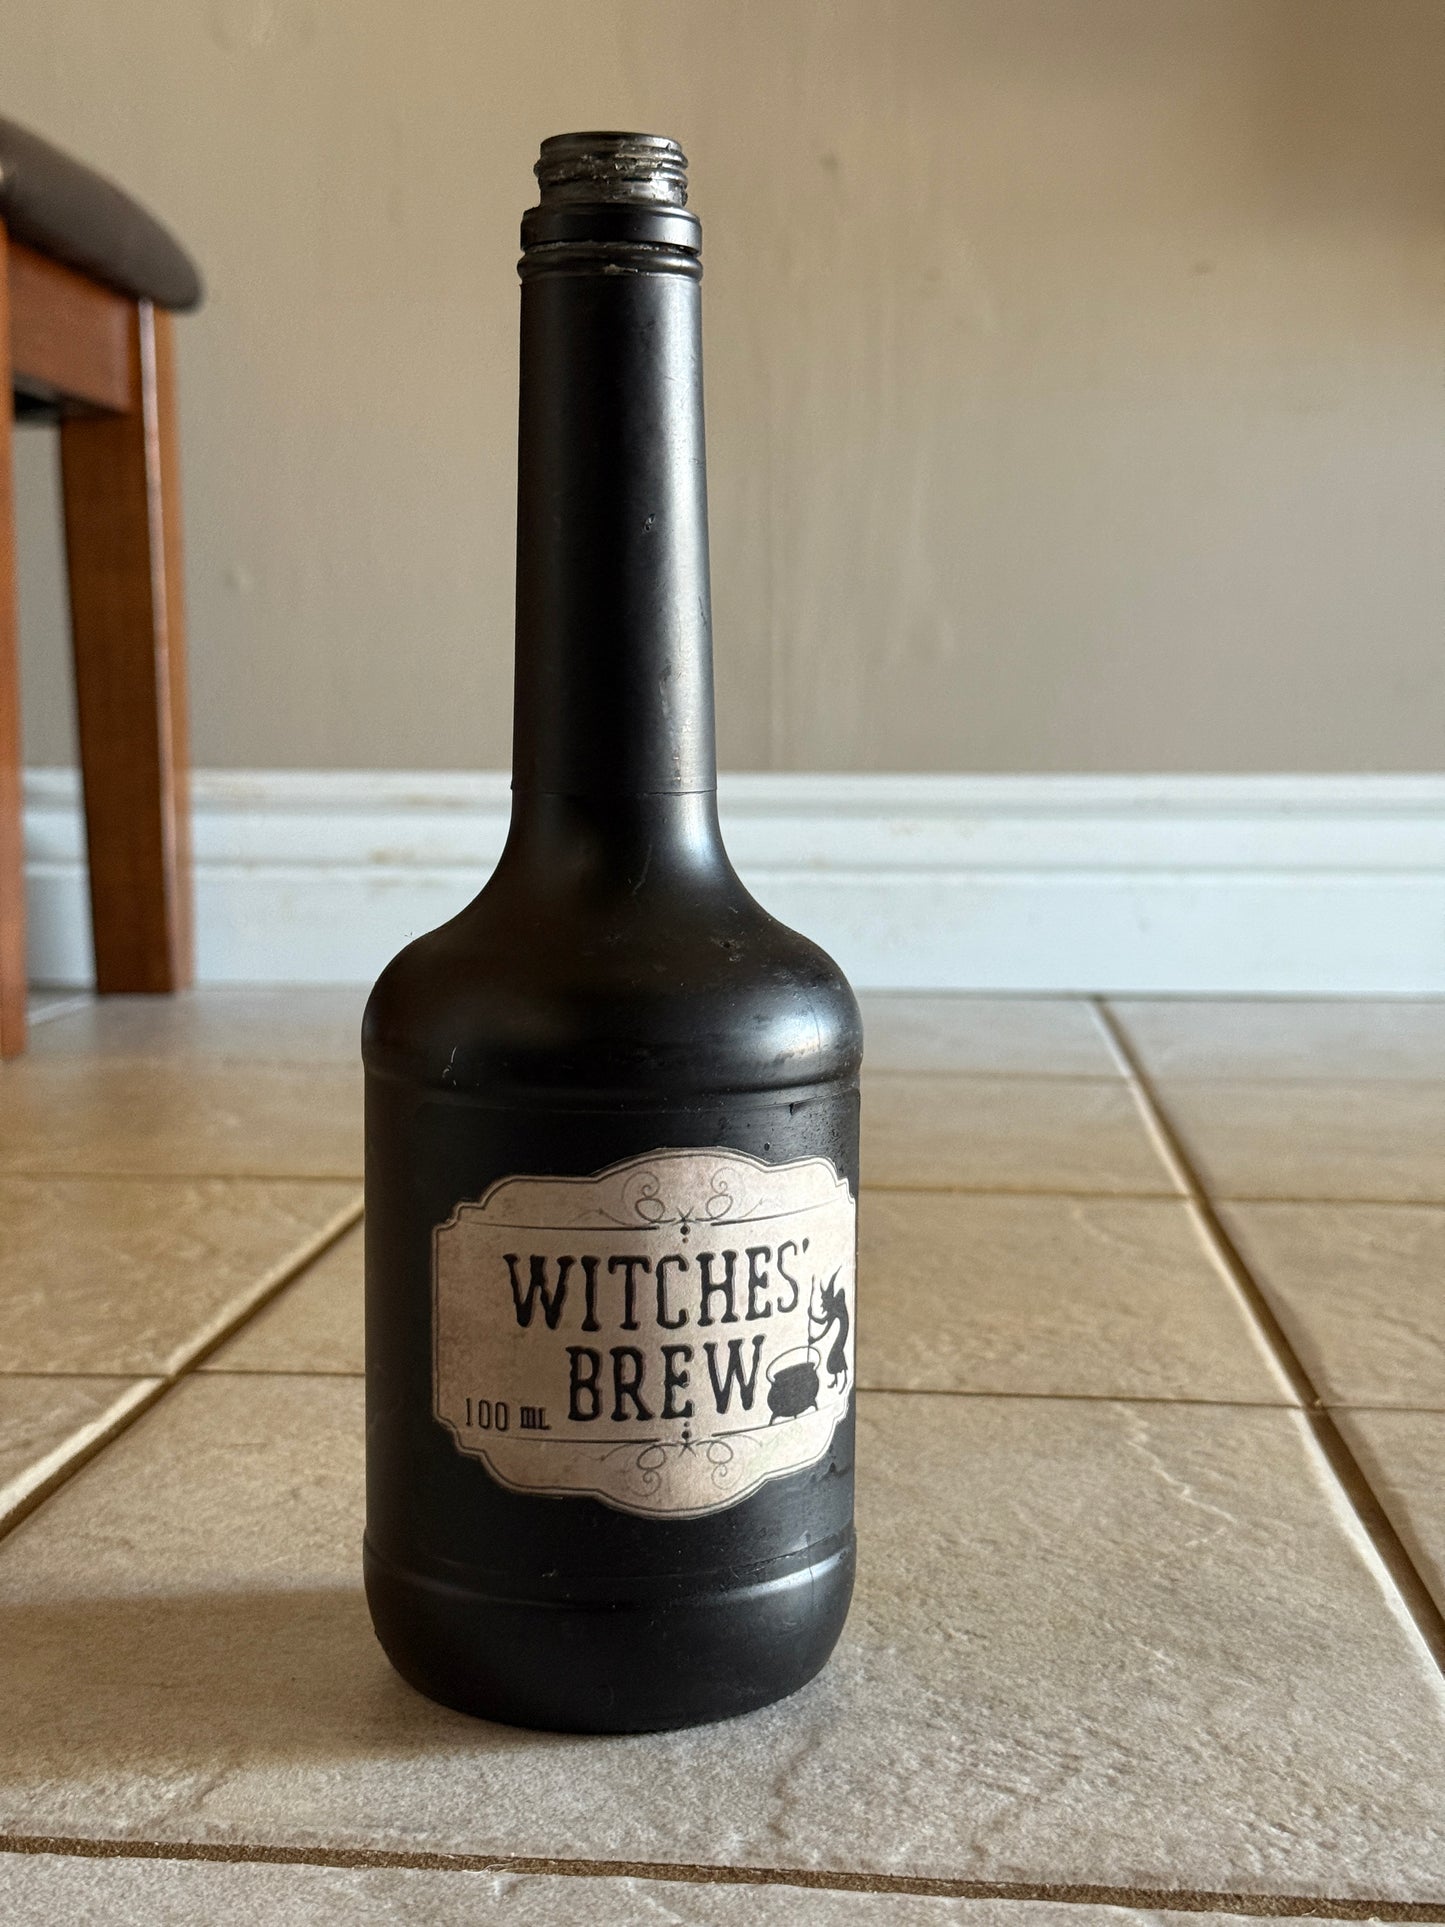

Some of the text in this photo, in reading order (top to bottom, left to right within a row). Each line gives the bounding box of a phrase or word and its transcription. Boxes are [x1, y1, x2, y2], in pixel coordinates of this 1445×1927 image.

[503, 1238, 809, 1332] WITCHES'
[465, 1398, 509, 1432] 100
[565, 1334, 766, 1422] BREW
